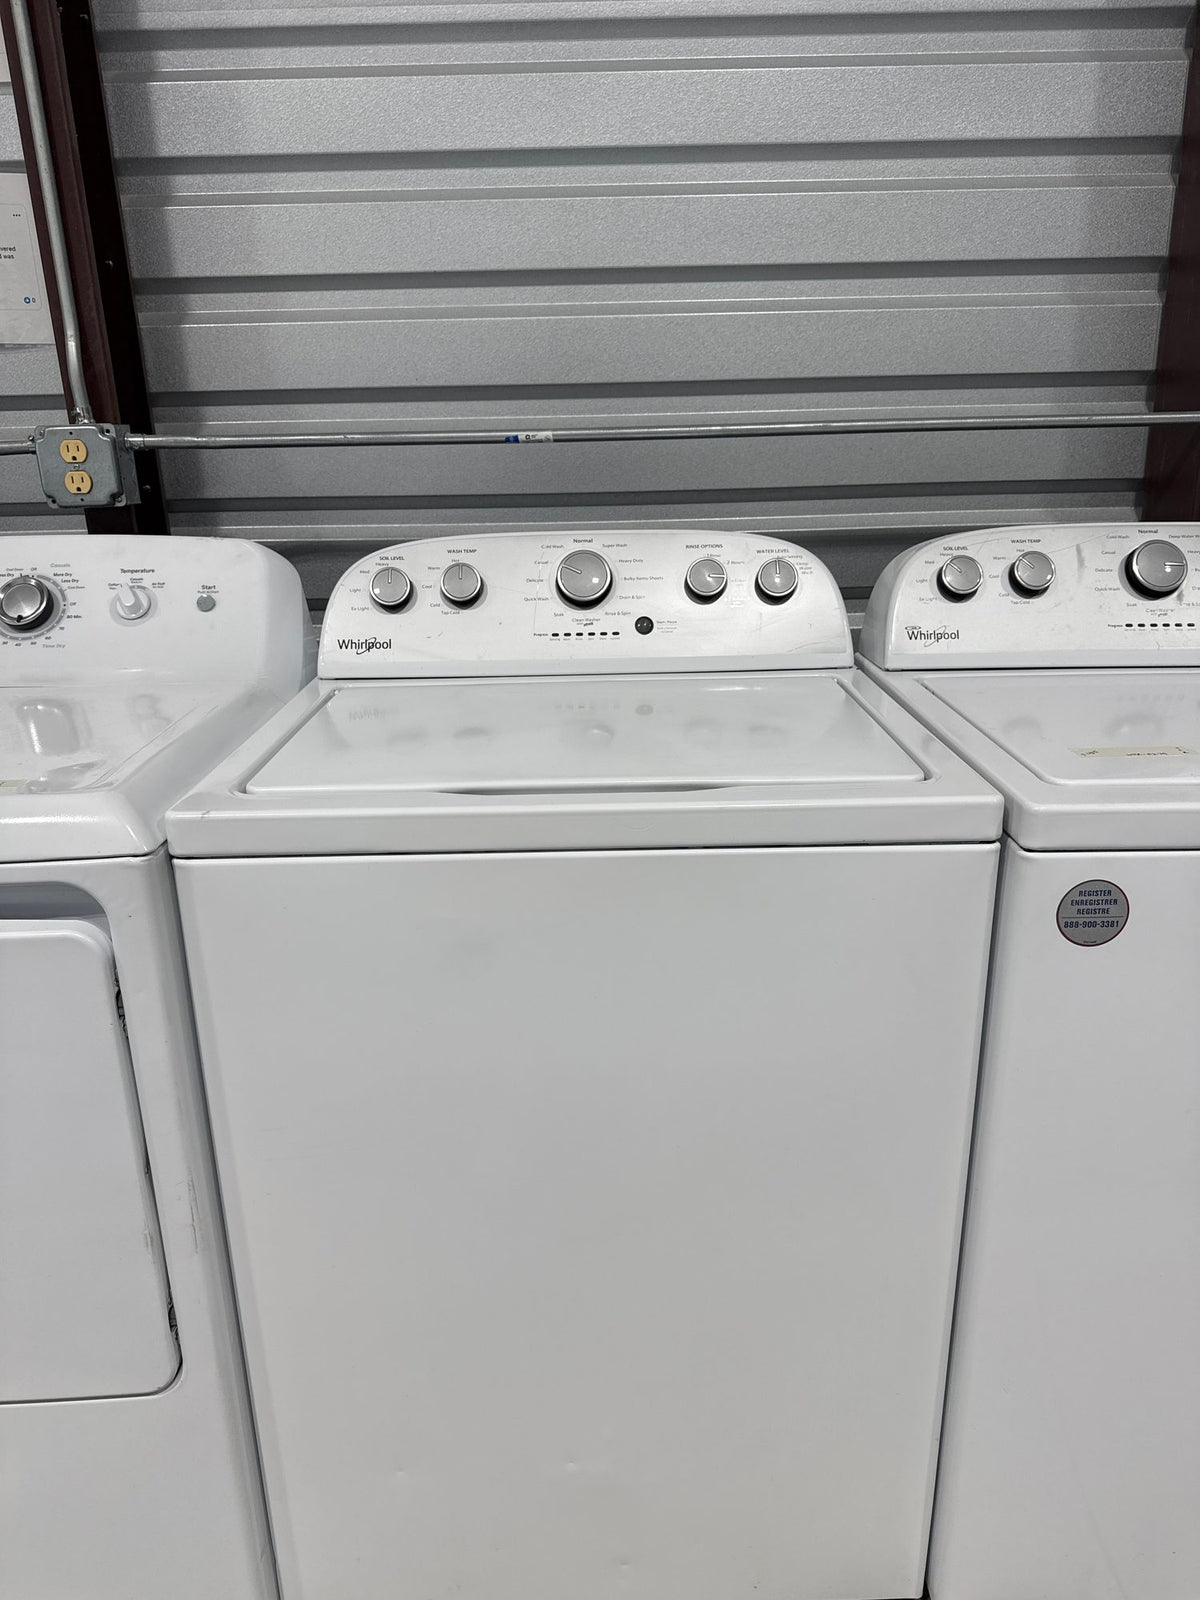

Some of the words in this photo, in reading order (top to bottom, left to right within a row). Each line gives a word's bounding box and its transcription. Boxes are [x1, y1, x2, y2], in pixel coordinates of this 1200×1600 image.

[906, 629, 959, 643] Whirlpool
[337, 638, 392, 653] Whirlpool
[1063, 920, 1119, 928] 888-900-3381
